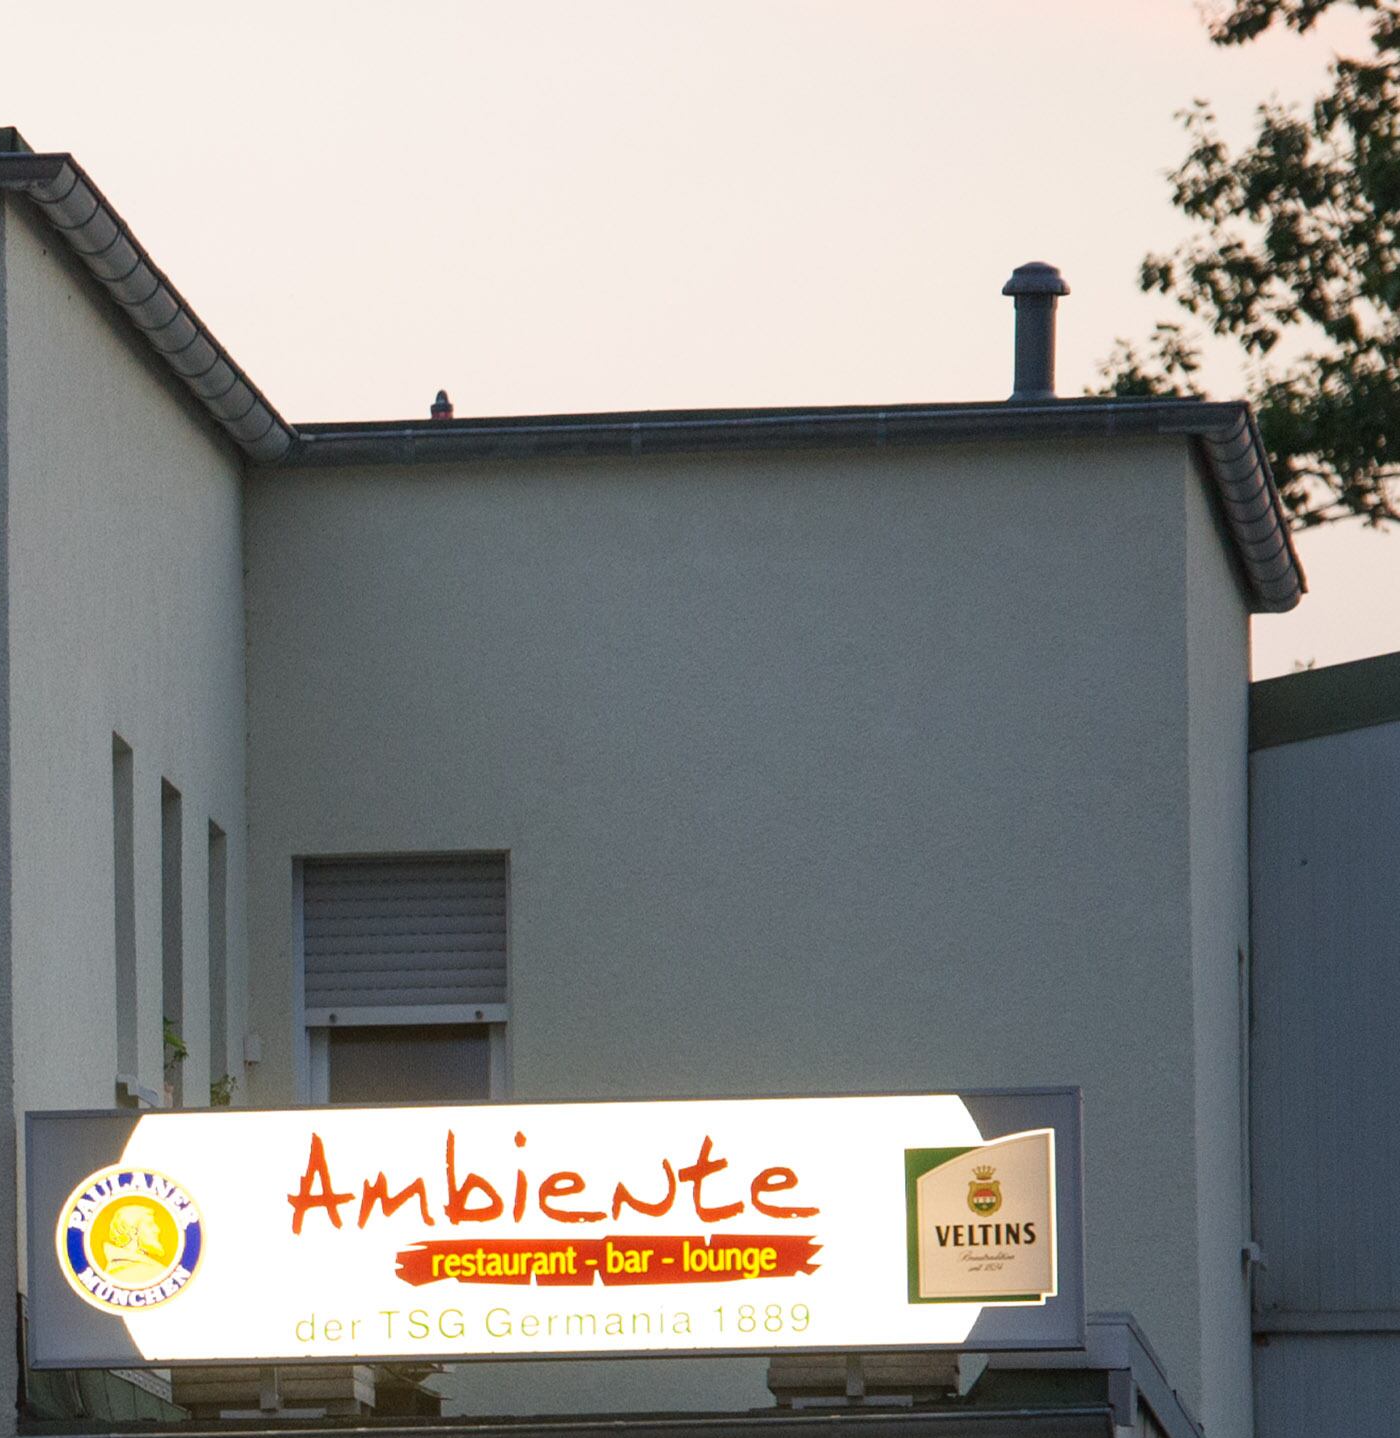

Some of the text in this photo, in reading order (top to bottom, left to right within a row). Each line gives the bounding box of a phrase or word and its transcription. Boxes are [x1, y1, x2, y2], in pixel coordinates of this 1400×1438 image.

[286, 1130, 821, 1235] Ambiente
[935, 1222, 1037, 1247] VELTINS
[431, 1245, 578, 1279] restaurant
[605, 1241, 655, 1275] bar
[682, 1240, 778, 1281] lounge
[294, 1301, 813, 1345] der TSG Germania 1889
